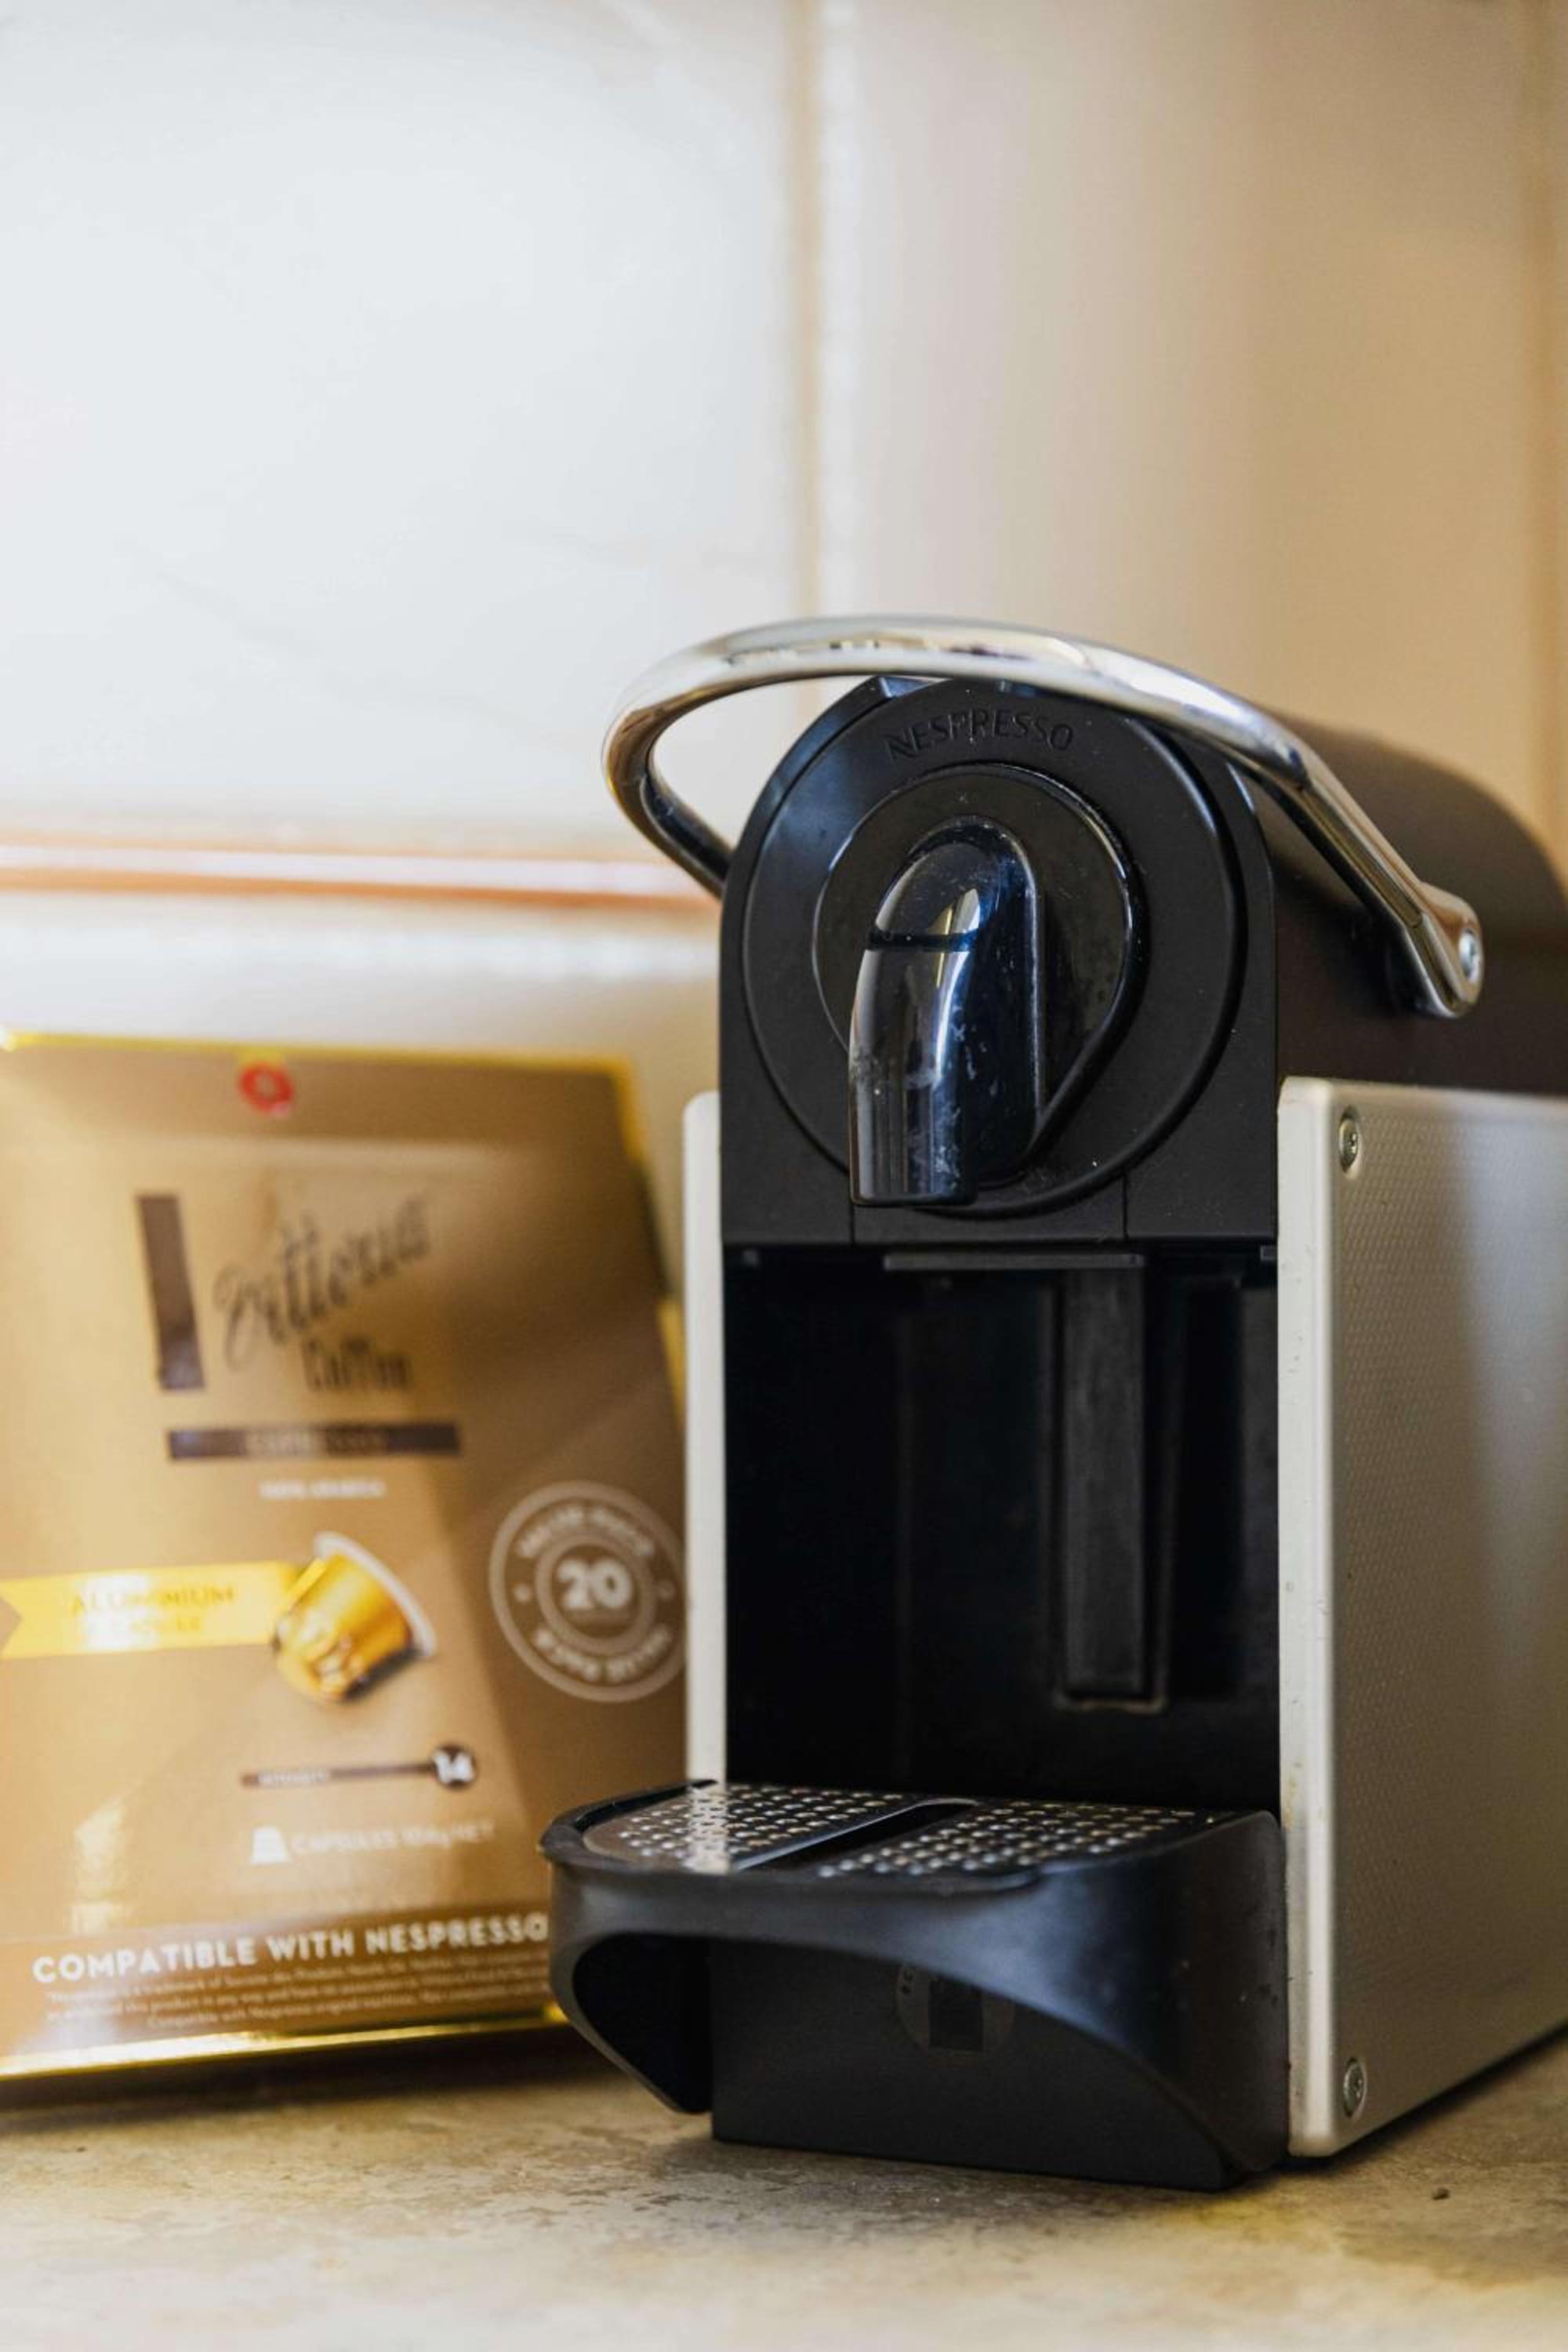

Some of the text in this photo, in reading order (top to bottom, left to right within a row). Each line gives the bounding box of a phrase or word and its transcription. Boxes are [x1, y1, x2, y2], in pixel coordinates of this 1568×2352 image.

[884, 707, 1073, 760] NESPRESSO
[556, 1557, 633, 1610] 20
[32, 1936, 257, 1983] COMPATIBLE
[266, 1929, 353, 1962] WITH
[365, 1911, 548, 1956] NESPRESSO
